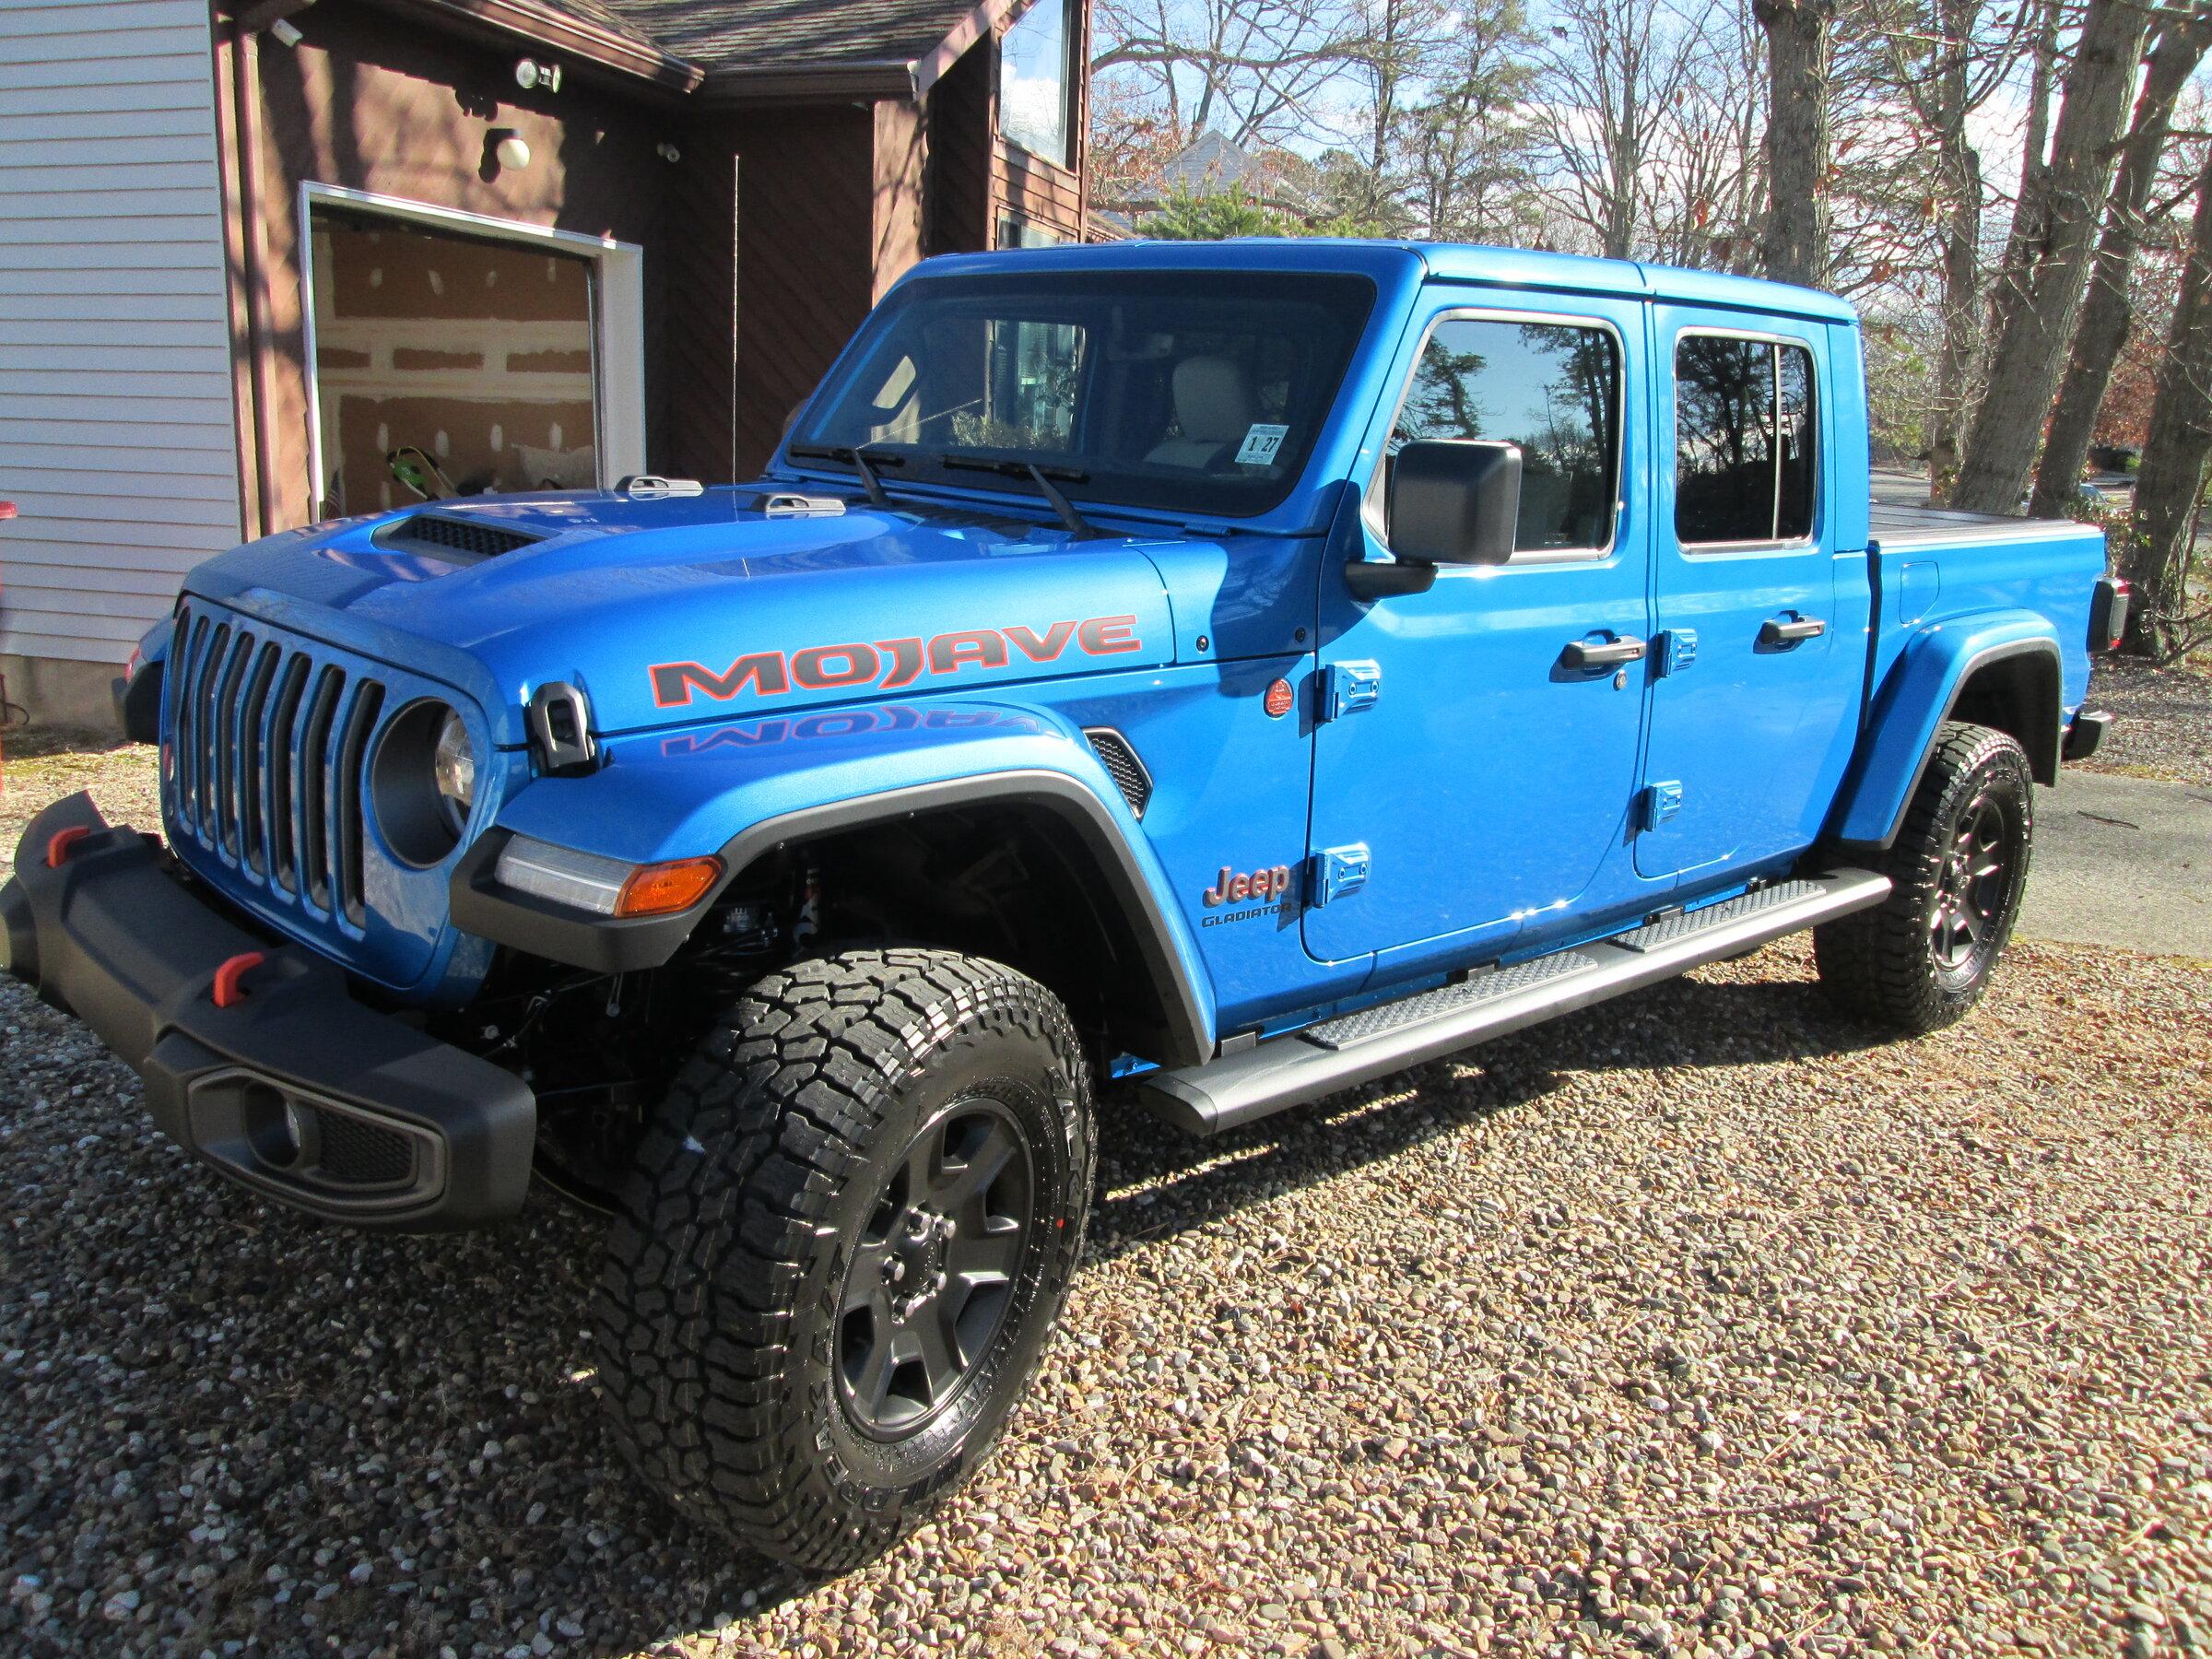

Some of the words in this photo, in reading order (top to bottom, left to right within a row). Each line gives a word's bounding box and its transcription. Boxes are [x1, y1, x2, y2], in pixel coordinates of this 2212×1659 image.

[1248, 436, 1258, 451] 1
[1261, 436, 1279, 453] 27
[648, 614, 1141, 708] MOJAVE
[1203, 865, 1289, 908] Jeep
